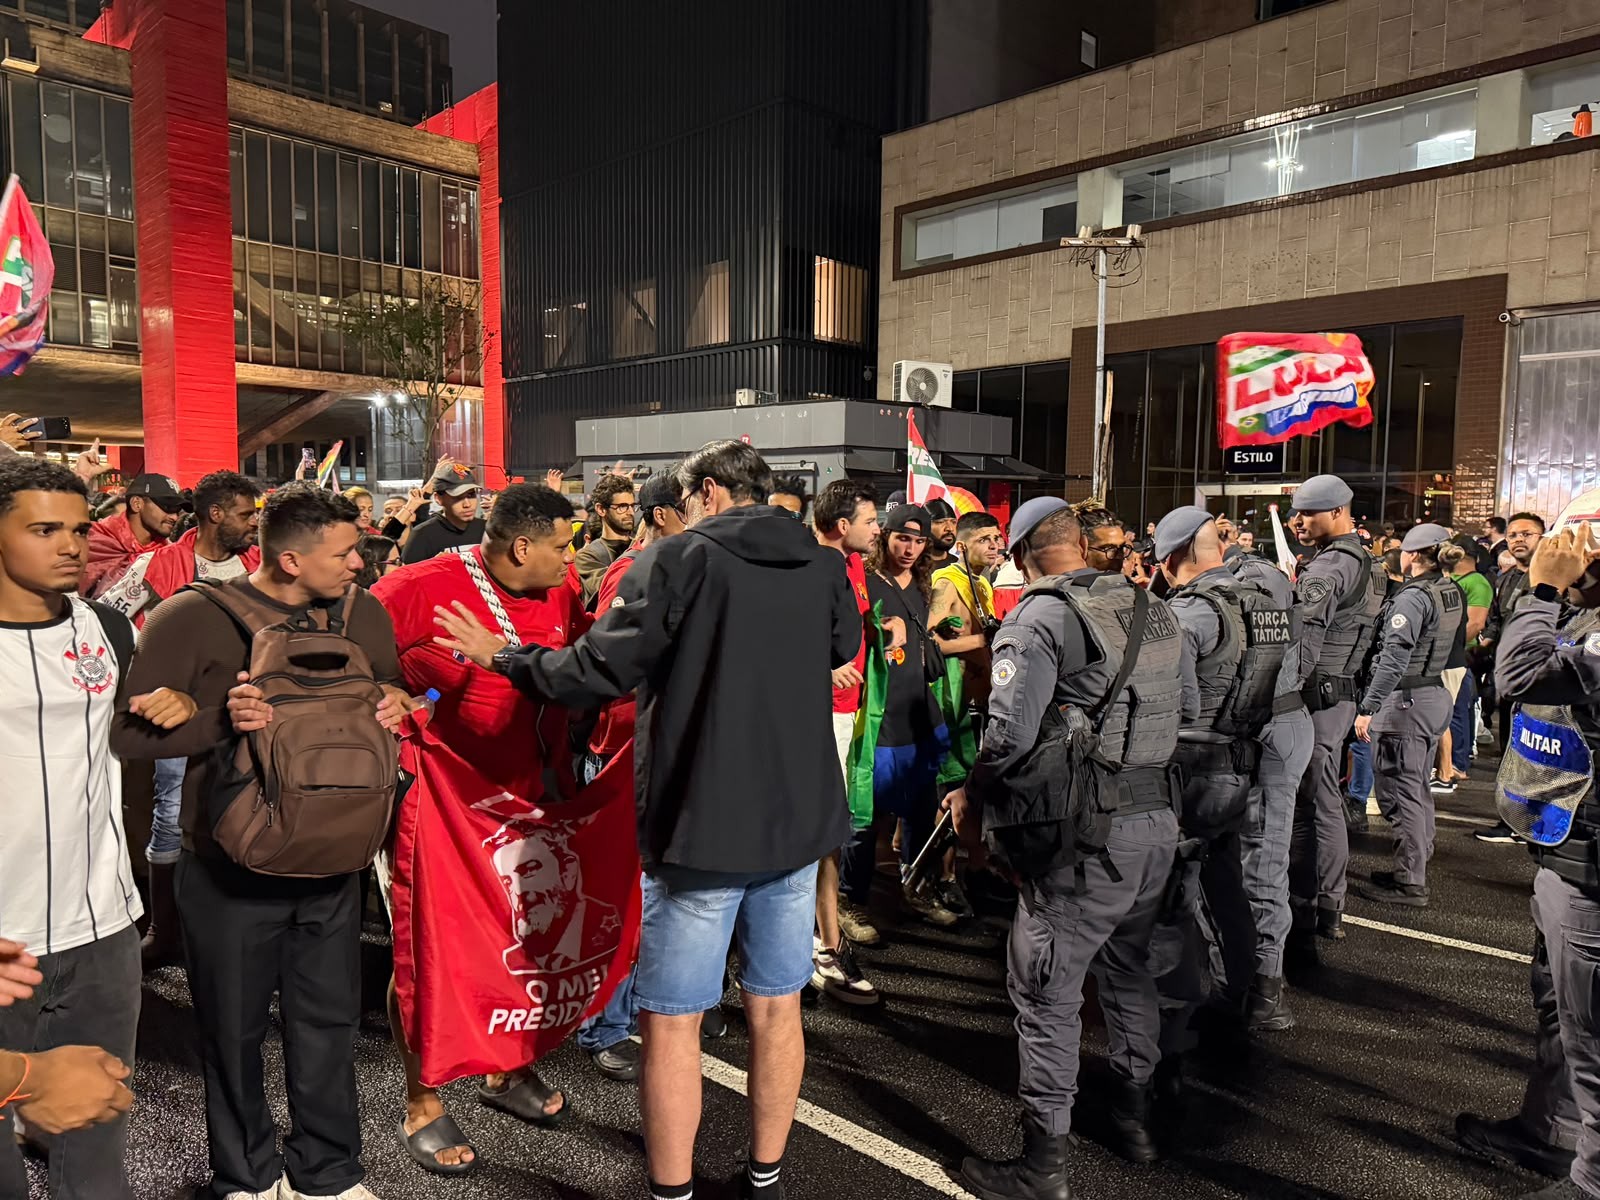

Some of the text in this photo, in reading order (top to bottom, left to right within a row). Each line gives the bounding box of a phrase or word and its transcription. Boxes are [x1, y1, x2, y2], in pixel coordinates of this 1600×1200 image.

[1120, 604, 1169, 628] PCIA
[1252, 611, 1290, 627] FORÇA
[1128, 620, 1177, 641] ILITAR
[1253, 626, 1291, 643] TÁTICA
